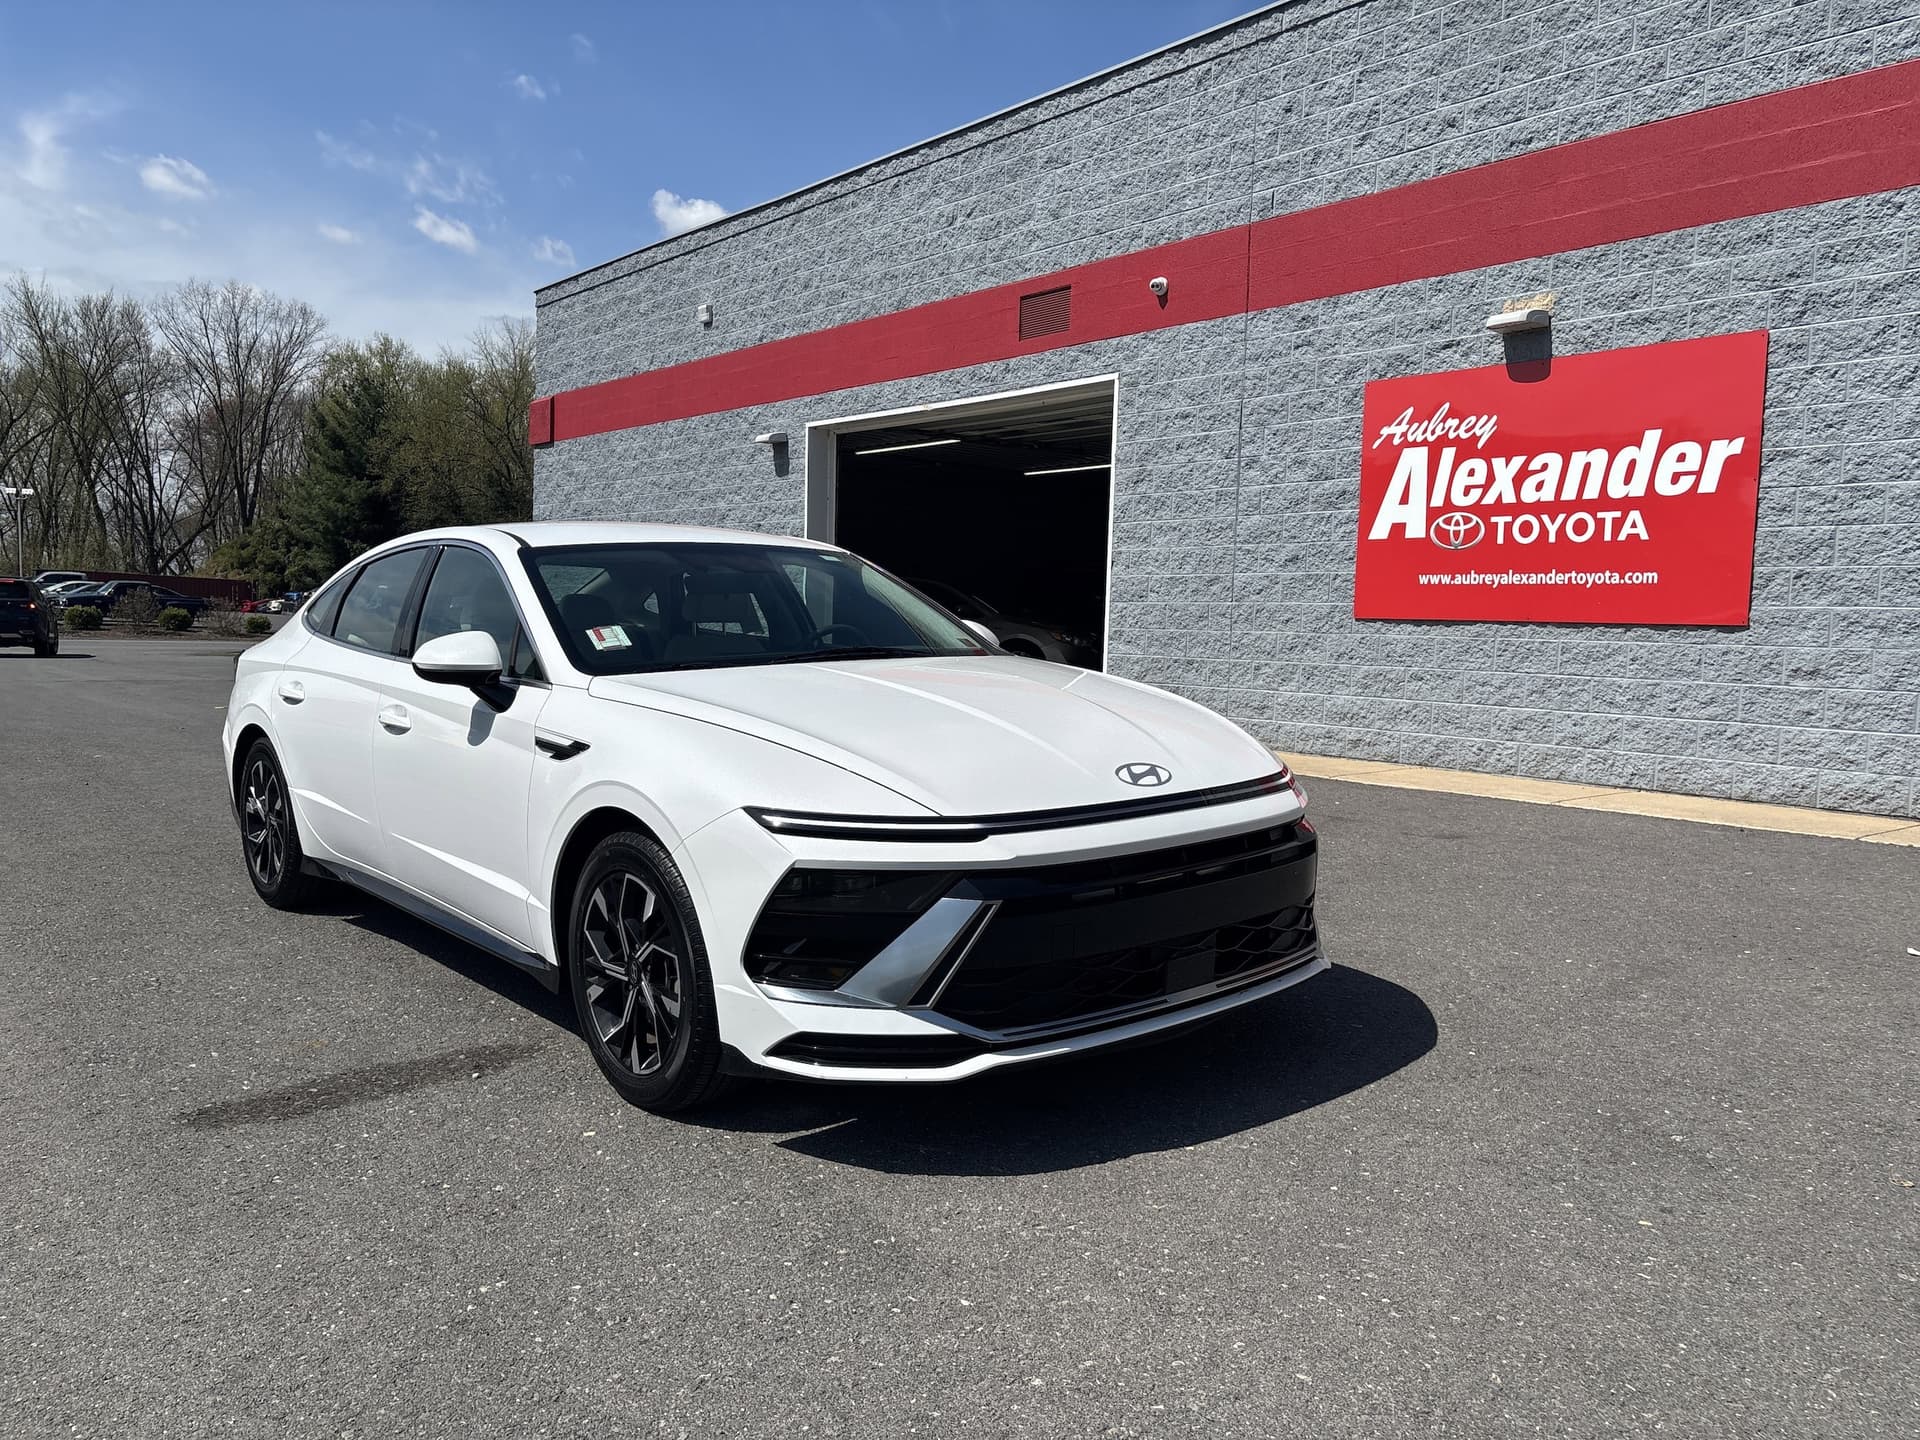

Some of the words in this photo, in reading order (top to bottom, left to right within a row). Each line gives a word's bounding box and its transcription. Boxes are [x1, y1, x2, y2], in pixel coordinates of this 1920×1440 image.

[1372, 401, 1498, 450] Aubrey
[1367, 428, 1745, 540] Alexander
[1490, 509, 1650, 545] TOYOTA
[1418, 569, 1659, 588] www.aubreyalexandertoyota.com
